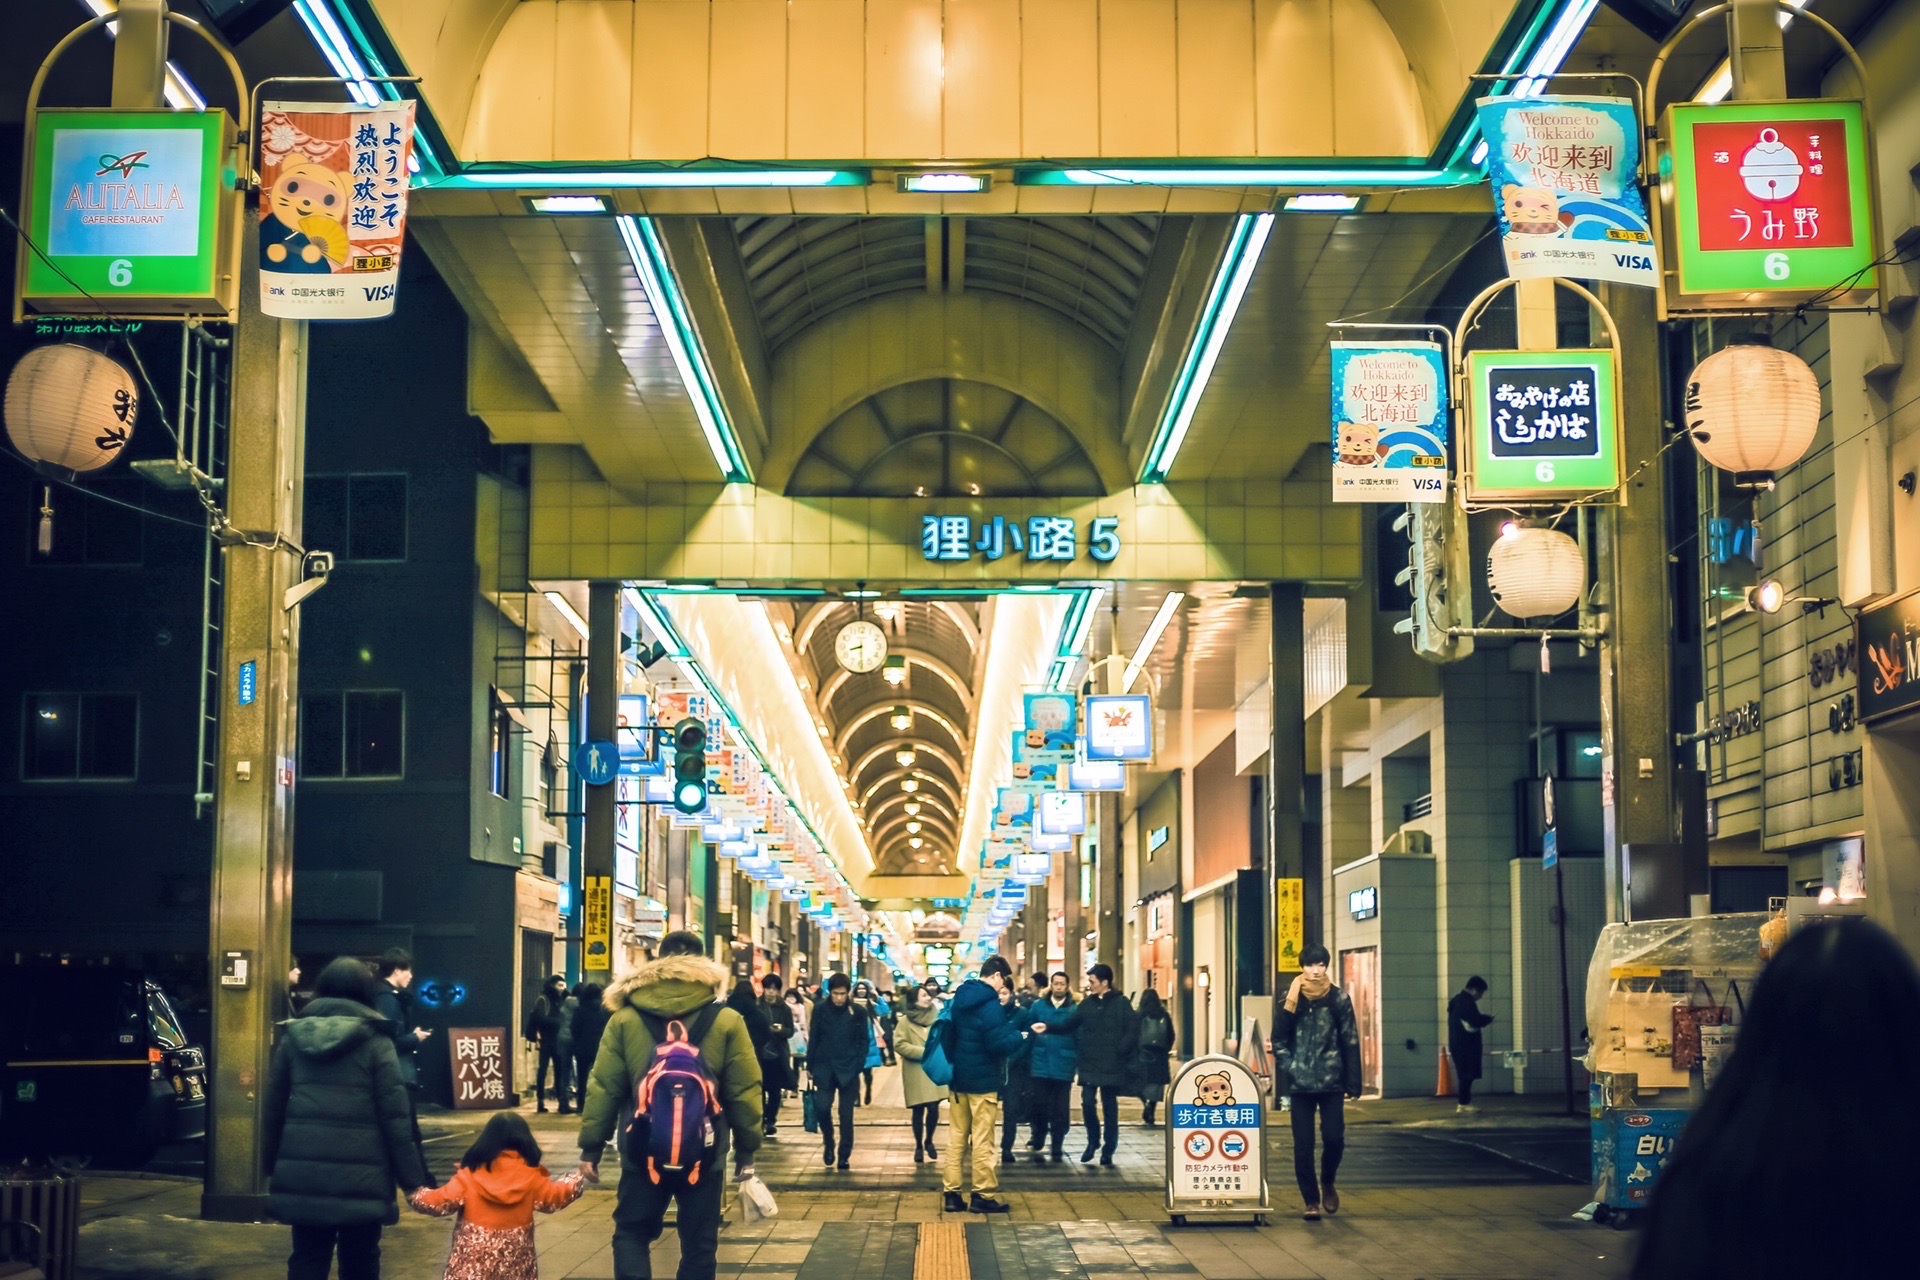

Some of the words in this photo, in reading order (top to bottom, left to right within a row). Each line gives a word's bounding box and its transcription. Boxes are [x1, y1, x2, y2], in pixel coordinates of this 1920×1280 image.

[1518, 112, 1585, 126] Welcome
[1587, 114, 1599, 126] to
[1526, 127, 1594, 140] Hokkaido
[1512, 142, 1613, 171] 欢迎来到
[351, 123, 379, 230] 热烈欢迎
[380, 122, 401, 228] ようこそ
[1530, 167, 1603, 195] 北海道
[65, 183, 184, 211] ALITALIA
[82, 215, 105, 224] CAFE
[107, 215, 165, 224] RESTAURANT
[1730, 207, 1819, 241] うみ野
[109, 259, 133, 287] 6
[1612, 253, 1653, 270] VISA
[1764, 252, 1790, 280] 6
[291, 287, 345, 297] 中国光大银行
[362, 284, 394, 301] VISA
[1359, 359, 1406, 370] Welcome
[1408, 360, 1418, 370] to
[1363, 370, 1414, 380] Hokkaido
[1350, 384, 1428, 402] 欢迎来到
[1495, 380, 1590, 410] おみやげの店
[1361, 403, 1418, 422] 北海道
[1495, 409, 1590, 444] しらかば
[1535, 461, 1555, 482] 6
[1413, 479, 1442, 490] VISA
[922, 515, 1076, 560] 狸小路
[1090, 515, 1121, 561] 5
[588, 887, 599, 935] 通行禁止
[456, 1036, 482, 1100] 肉バル
[480, 1036, 504, 1100] 炭火焼
[1178, 1108, 1254, 1125] 歩行者専用
[1185, 1164, 1249, 1172] 防犯カメラ作動中
